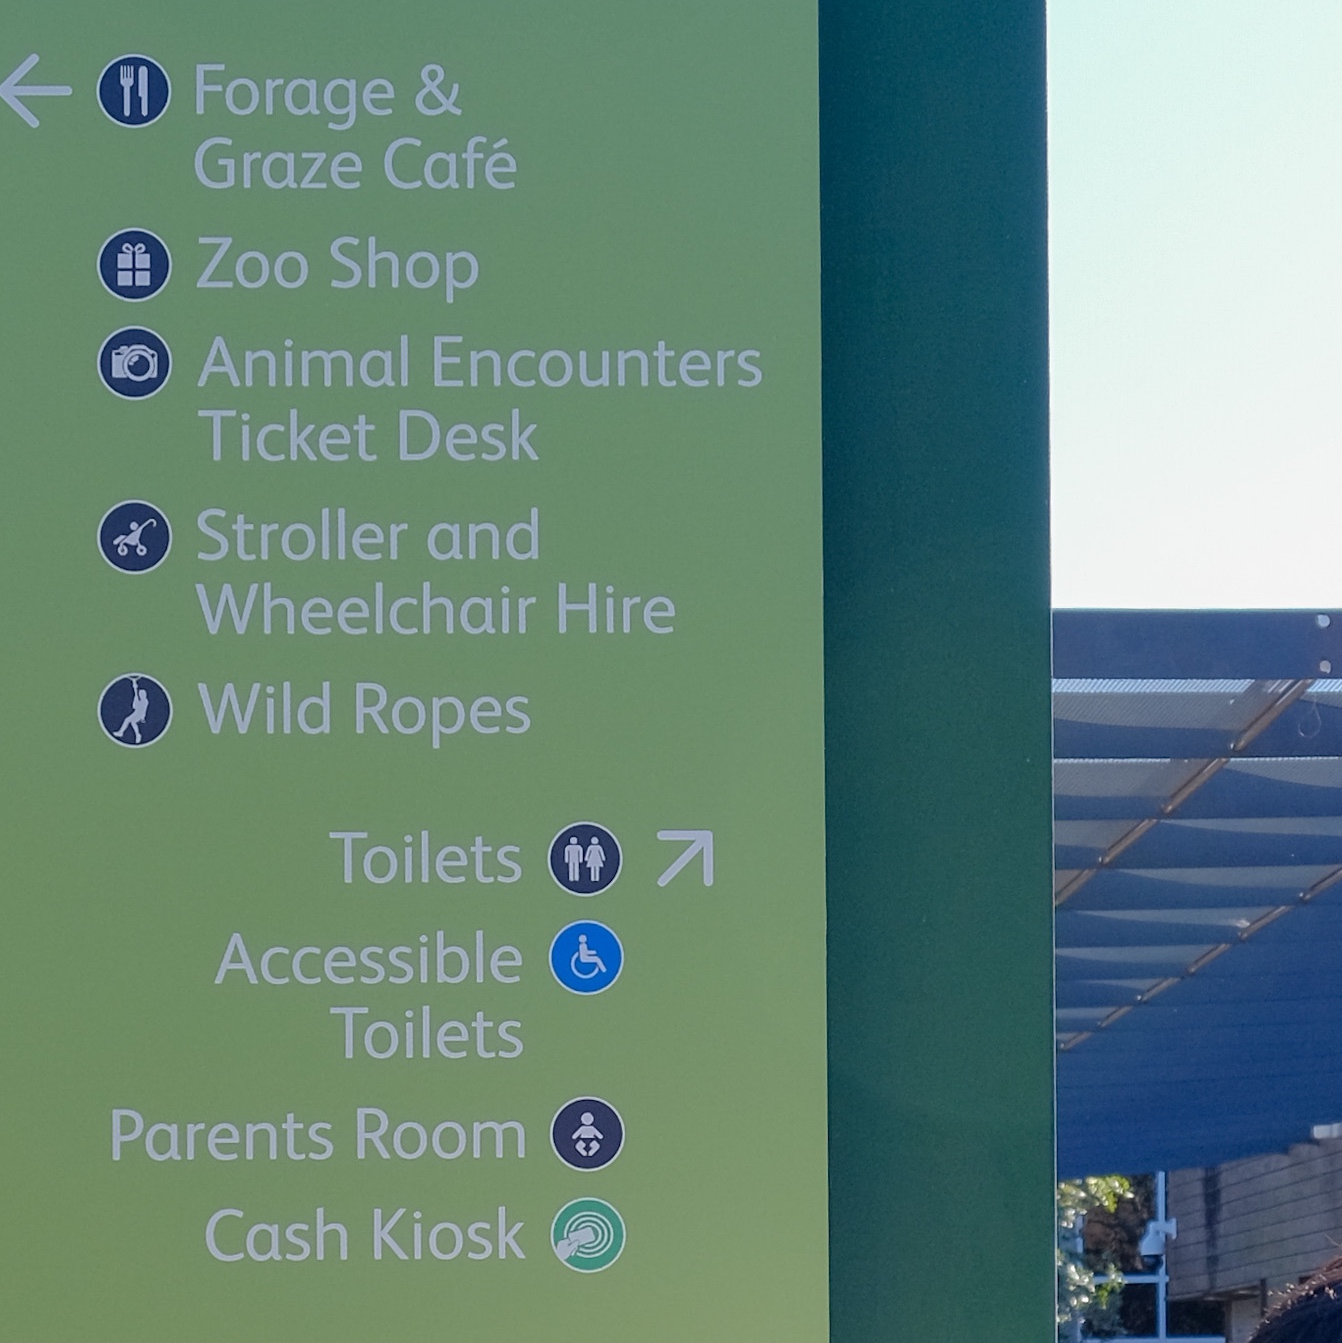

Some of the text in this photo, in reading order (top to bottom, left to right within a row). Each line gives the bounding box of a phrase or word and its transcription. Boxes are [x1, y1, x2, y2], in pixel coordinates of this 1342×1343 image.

[195, 63, 463, 131] Forage &
[194, 135, 517, 190] Graze Café
[196, 235, 479, 304] Zoo Shop
[197, 334, 763, 388] Animal Encounters
[197, 407, 540, 462] Ticket Desk
[197, 506, 539, 562] Stroller and
[194, 580, 676, 636] Wheelchair Hire
[197, 680, 531, 750] Wild Ropes
[328, 829, 523, 885] Toilets
[214, 929, 523, 985] Accessible
[329, 1004, 524, 1060] Toilets
[111, 1106, 526, 1162] Parents Room
[205, 1205, 526, 1262] Cash Kiosk
